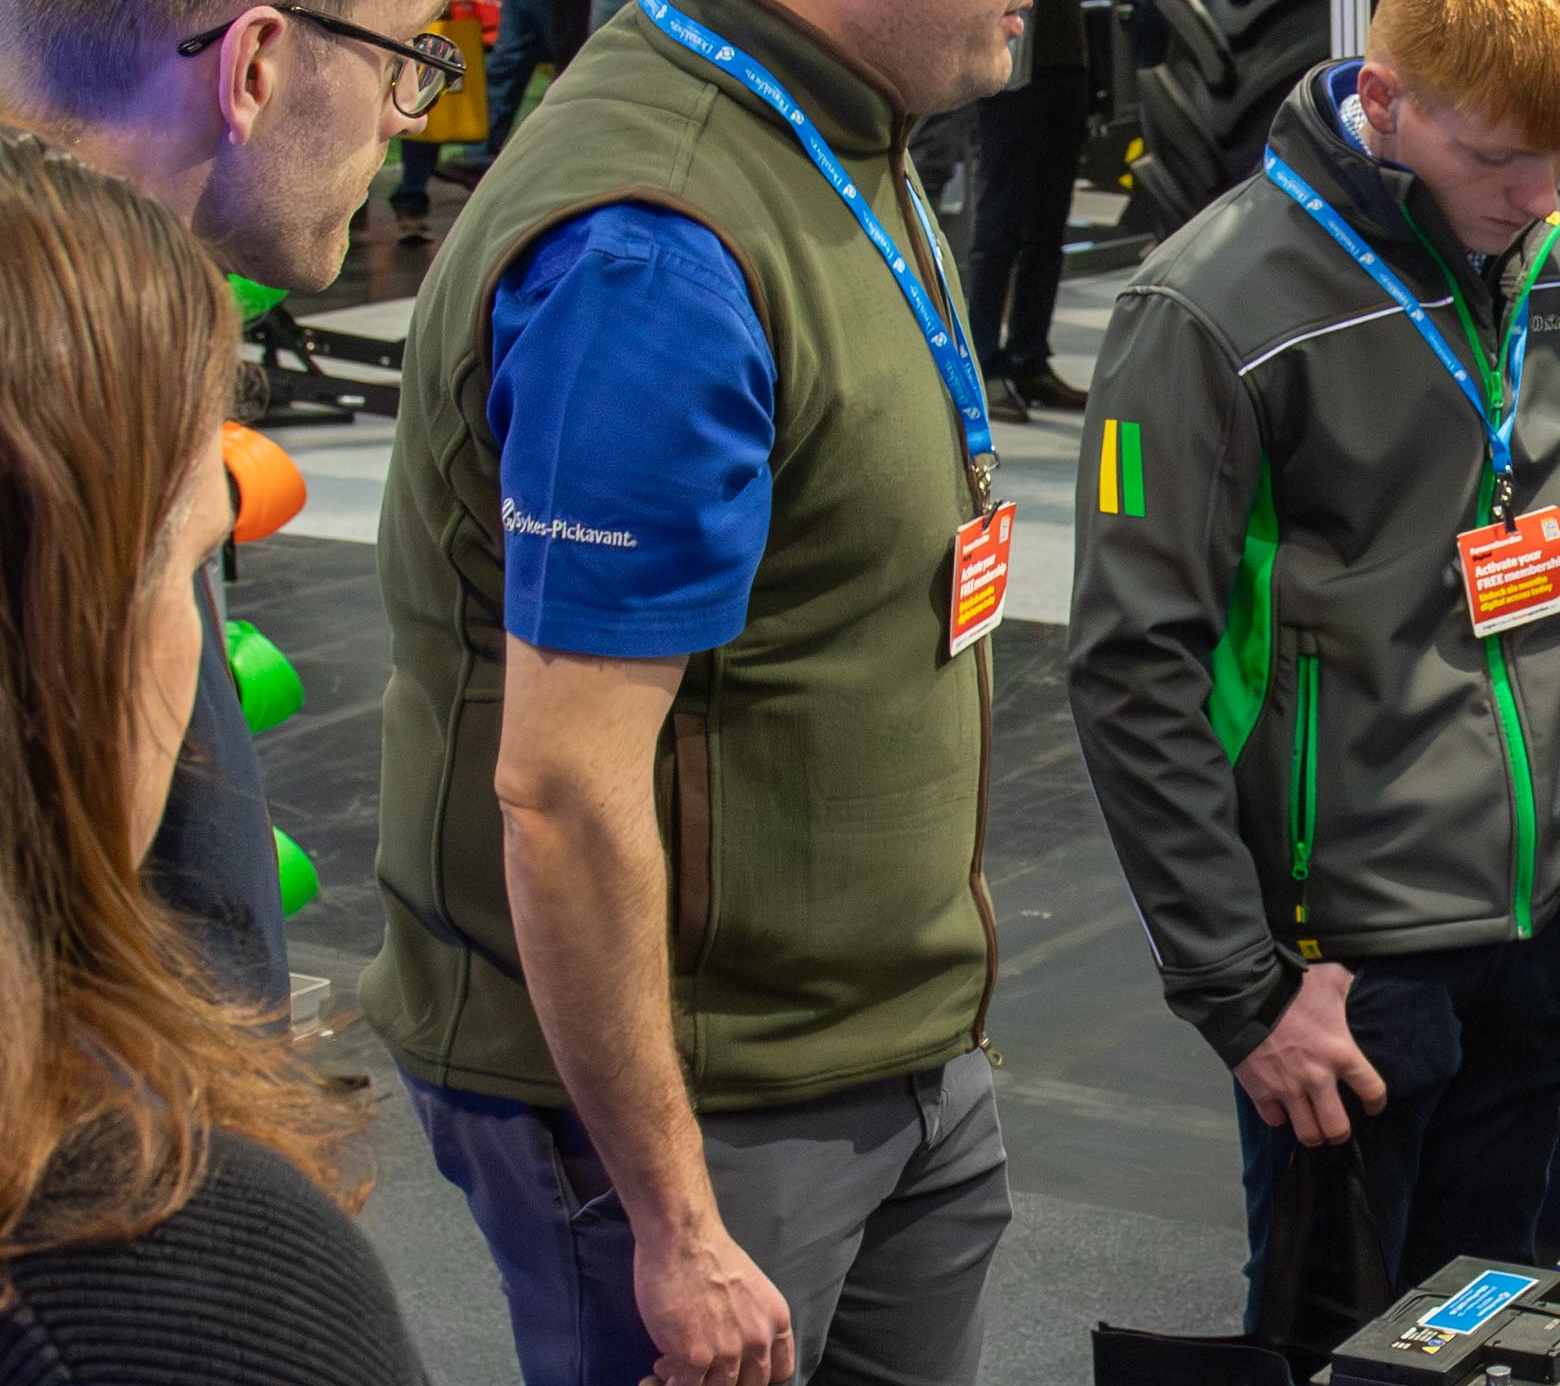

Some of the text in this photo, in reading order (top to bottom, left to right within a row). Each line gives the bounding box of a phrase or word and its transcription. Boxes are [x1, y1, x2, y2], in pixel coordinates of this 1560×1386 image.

[515, 511, 631, 547] Sykes-Pickavant
[1475, 550, 1542, 578] Activate your
[1477, 573, 1504, 591] FREE
